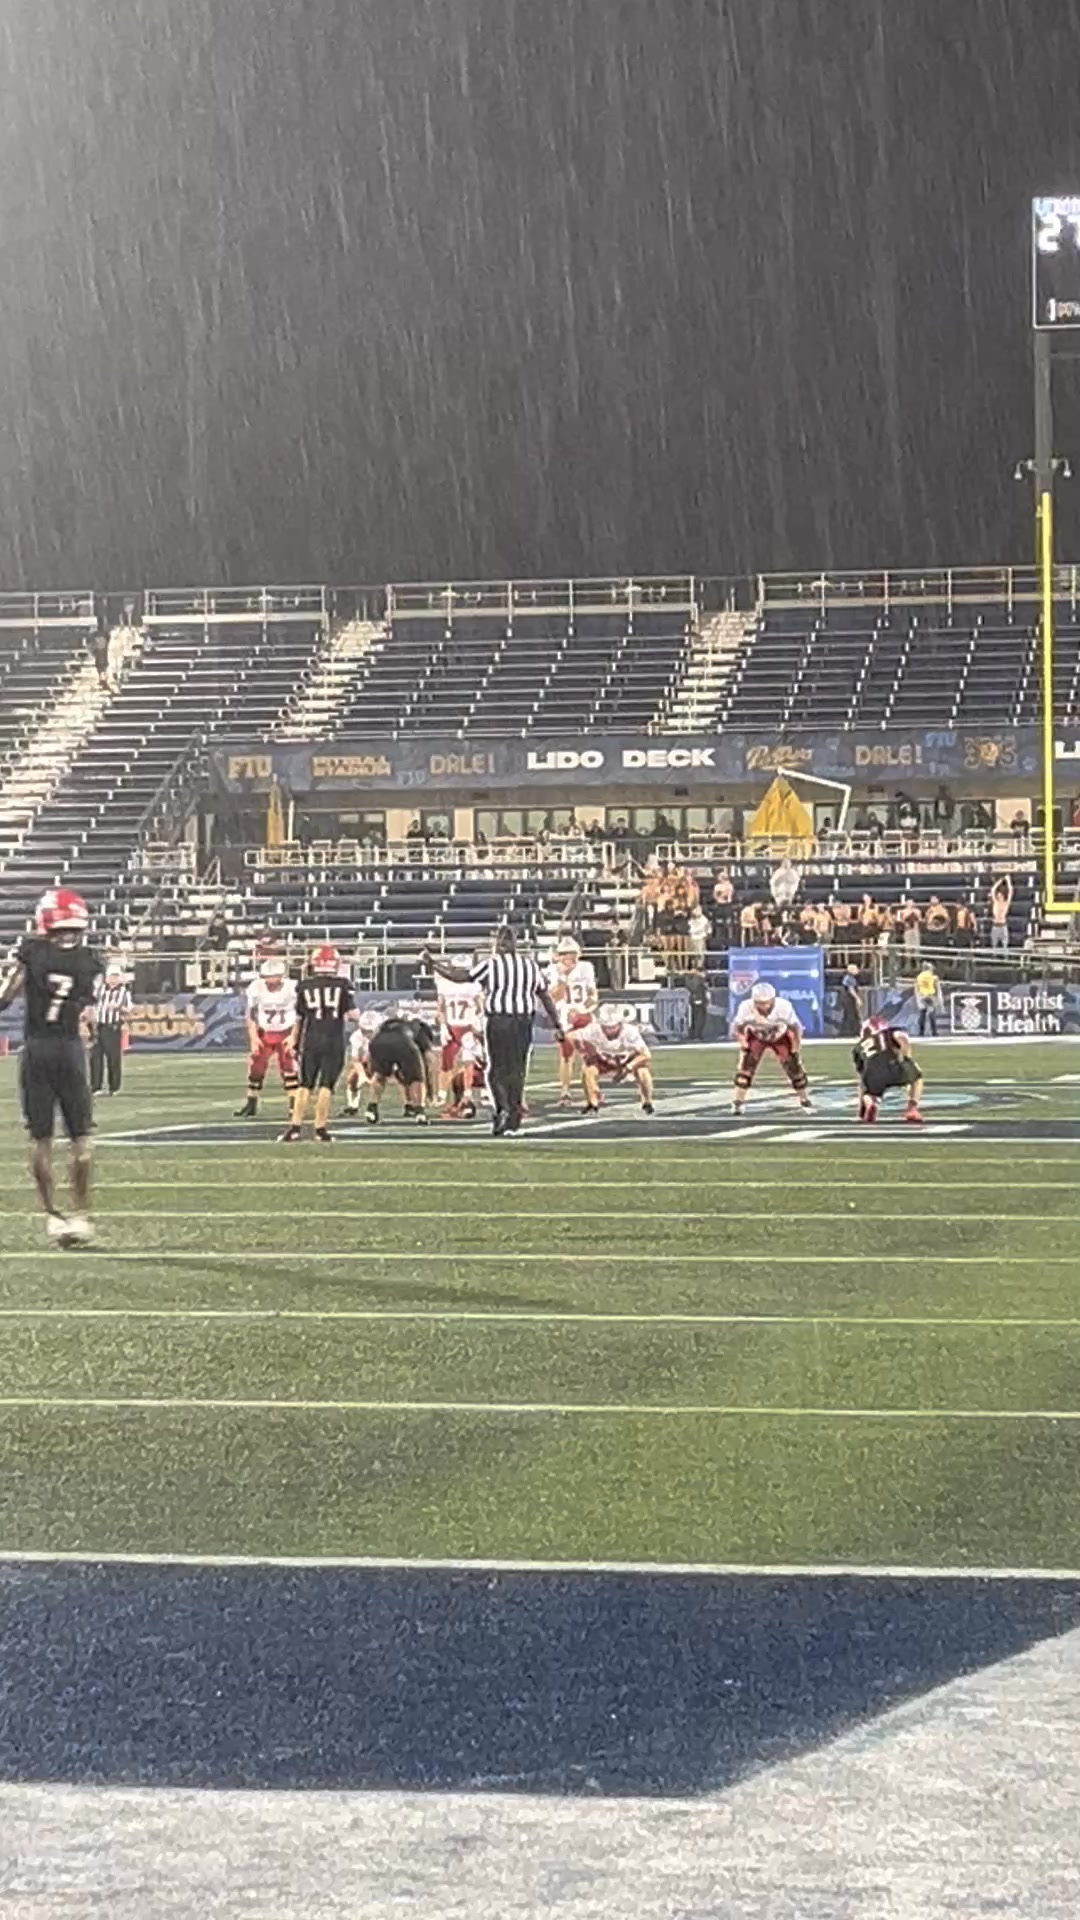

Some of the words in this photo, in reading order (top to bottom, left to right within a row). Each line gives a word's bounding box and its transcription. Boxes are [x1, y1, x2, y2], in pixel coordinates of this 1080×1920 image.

[527, 751, 604, 769] LIDO
[622, 748, 715, 768] DECK
[46, 973, 73, 1022] 7
[304, 987, 341, 1019] 44
[997, 992, 1064, 1011] Baptist
[448, 1000, 470, 1019] 17
[997, 1014, 1060, 1033] Health
[861, 1033, 886, 1056] 21
